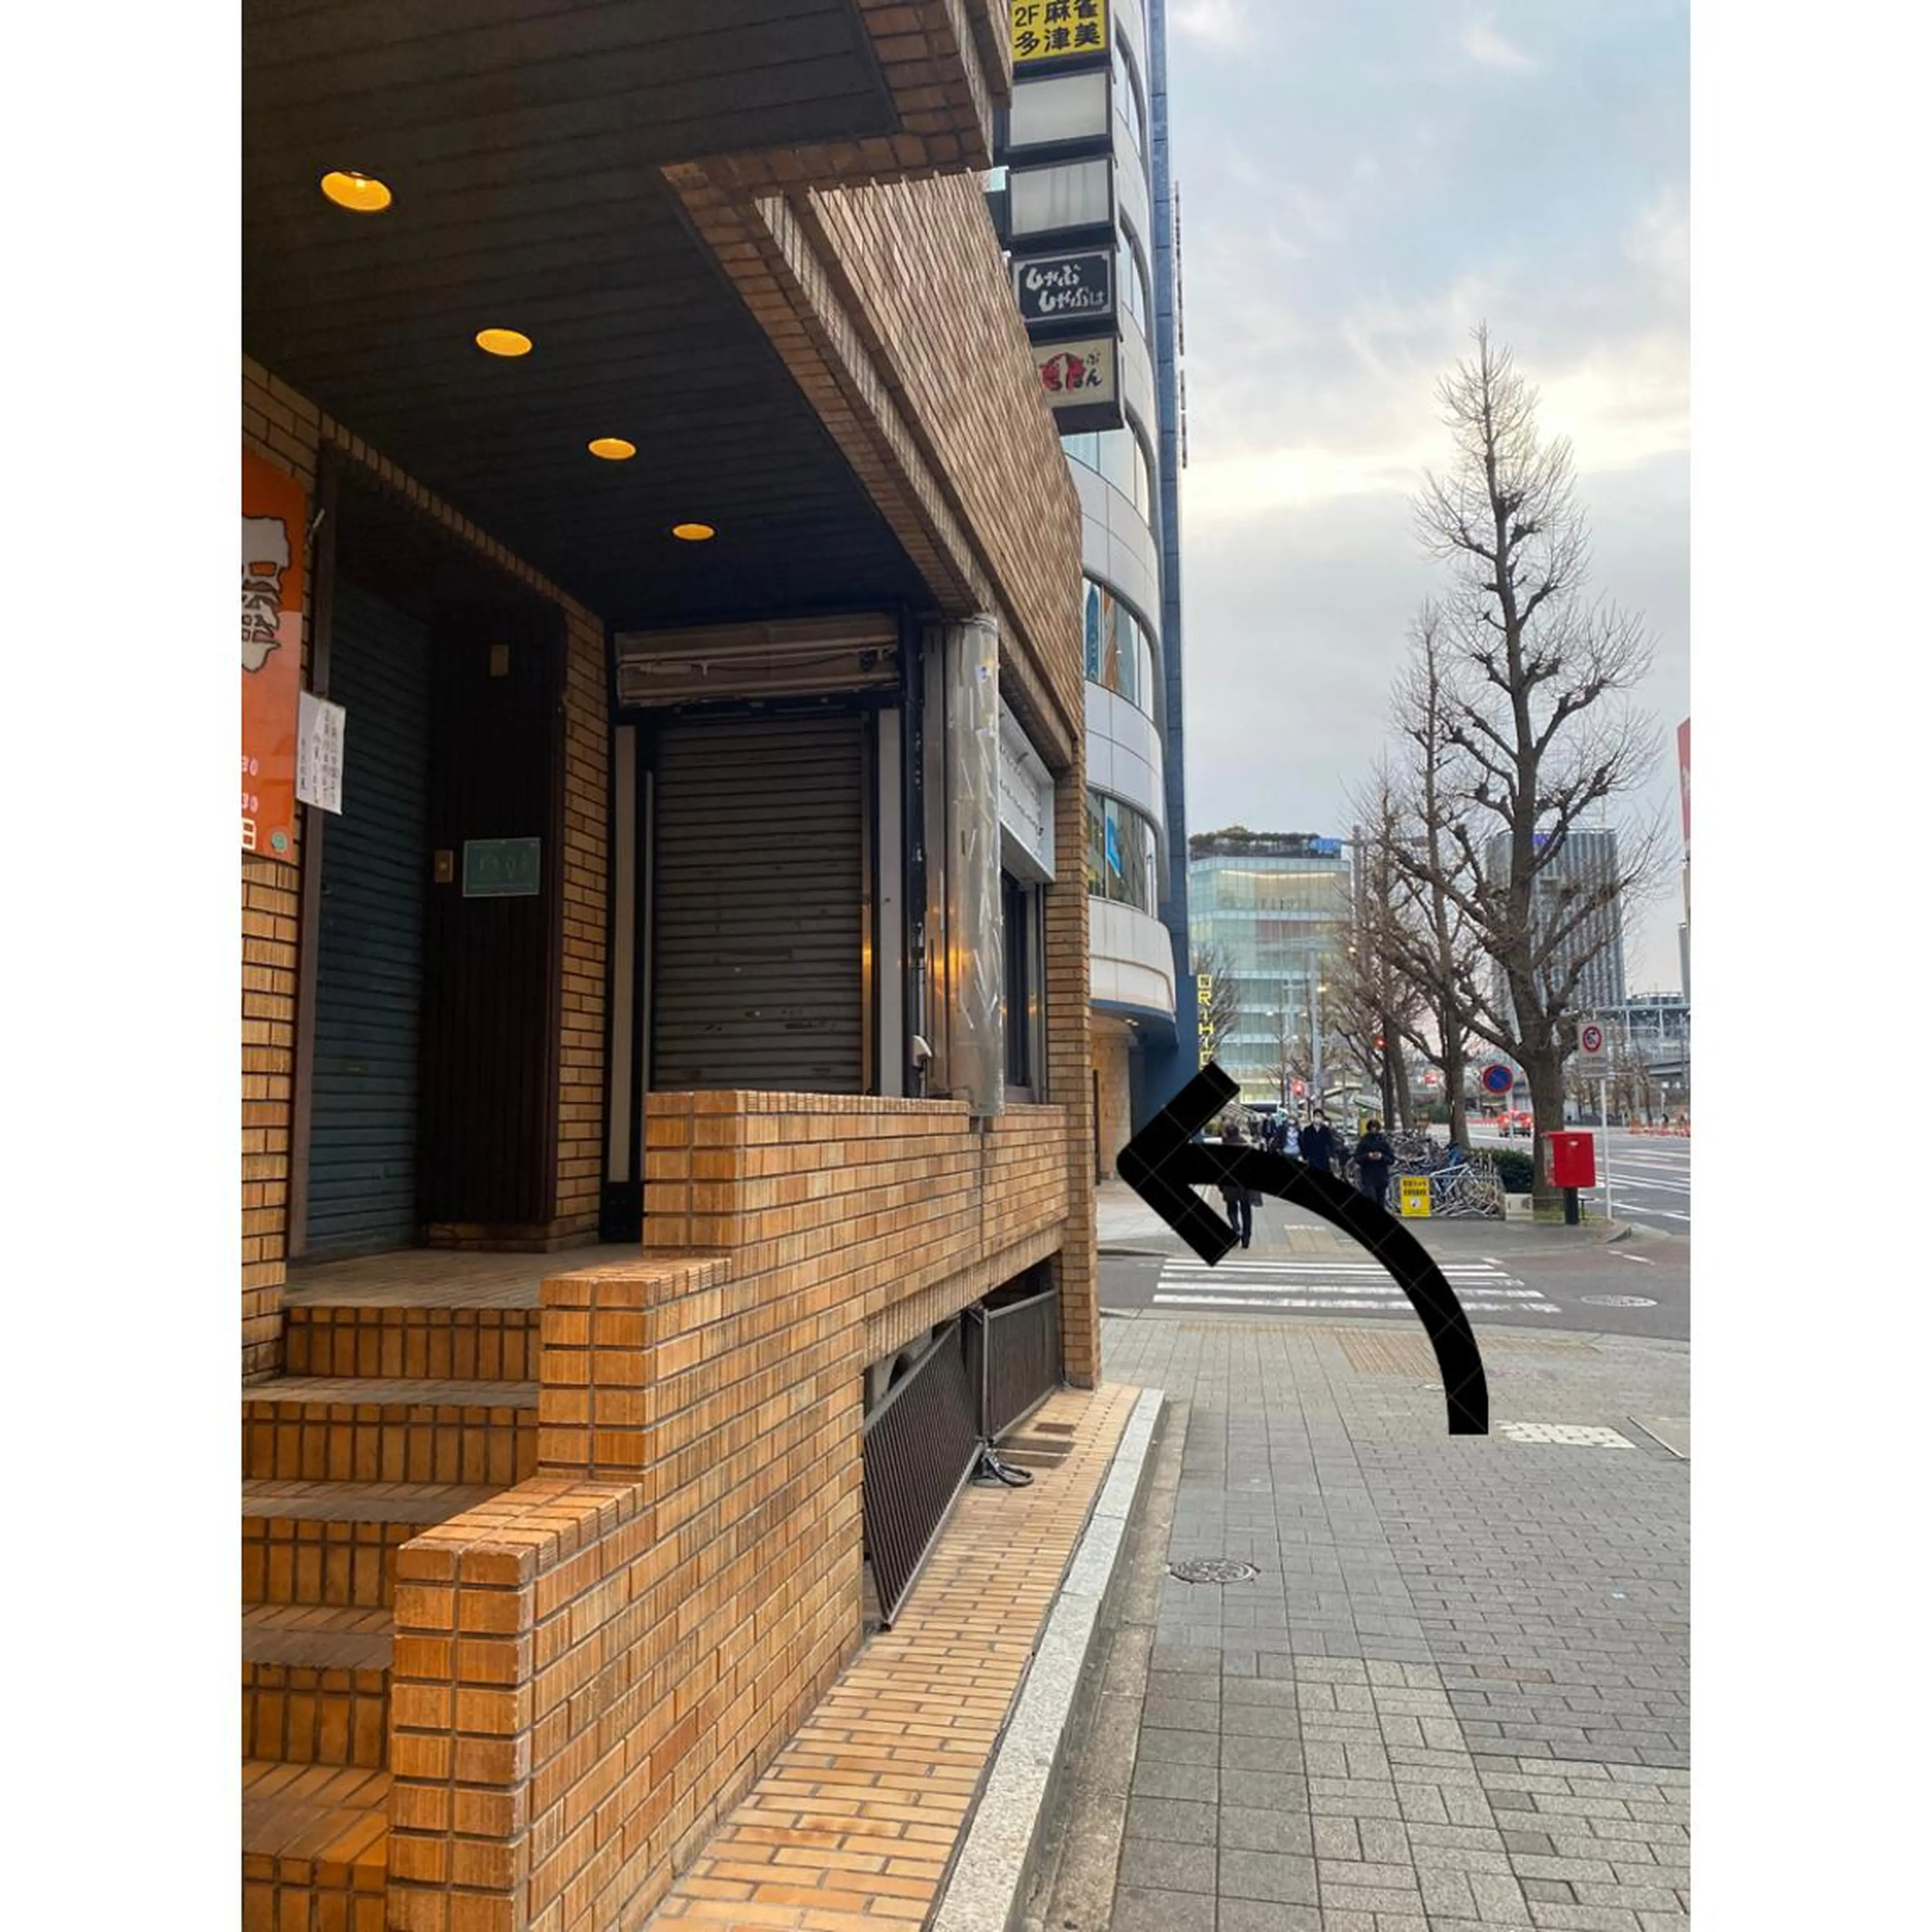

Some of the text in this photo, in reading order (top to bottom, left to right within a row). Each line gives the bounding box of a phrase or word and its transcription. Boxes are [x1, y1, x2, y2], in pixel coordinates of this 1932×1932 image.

[1015, 22, 1101, 56] 多津美
[1026, 264, 1082, 291] しゃぶ
